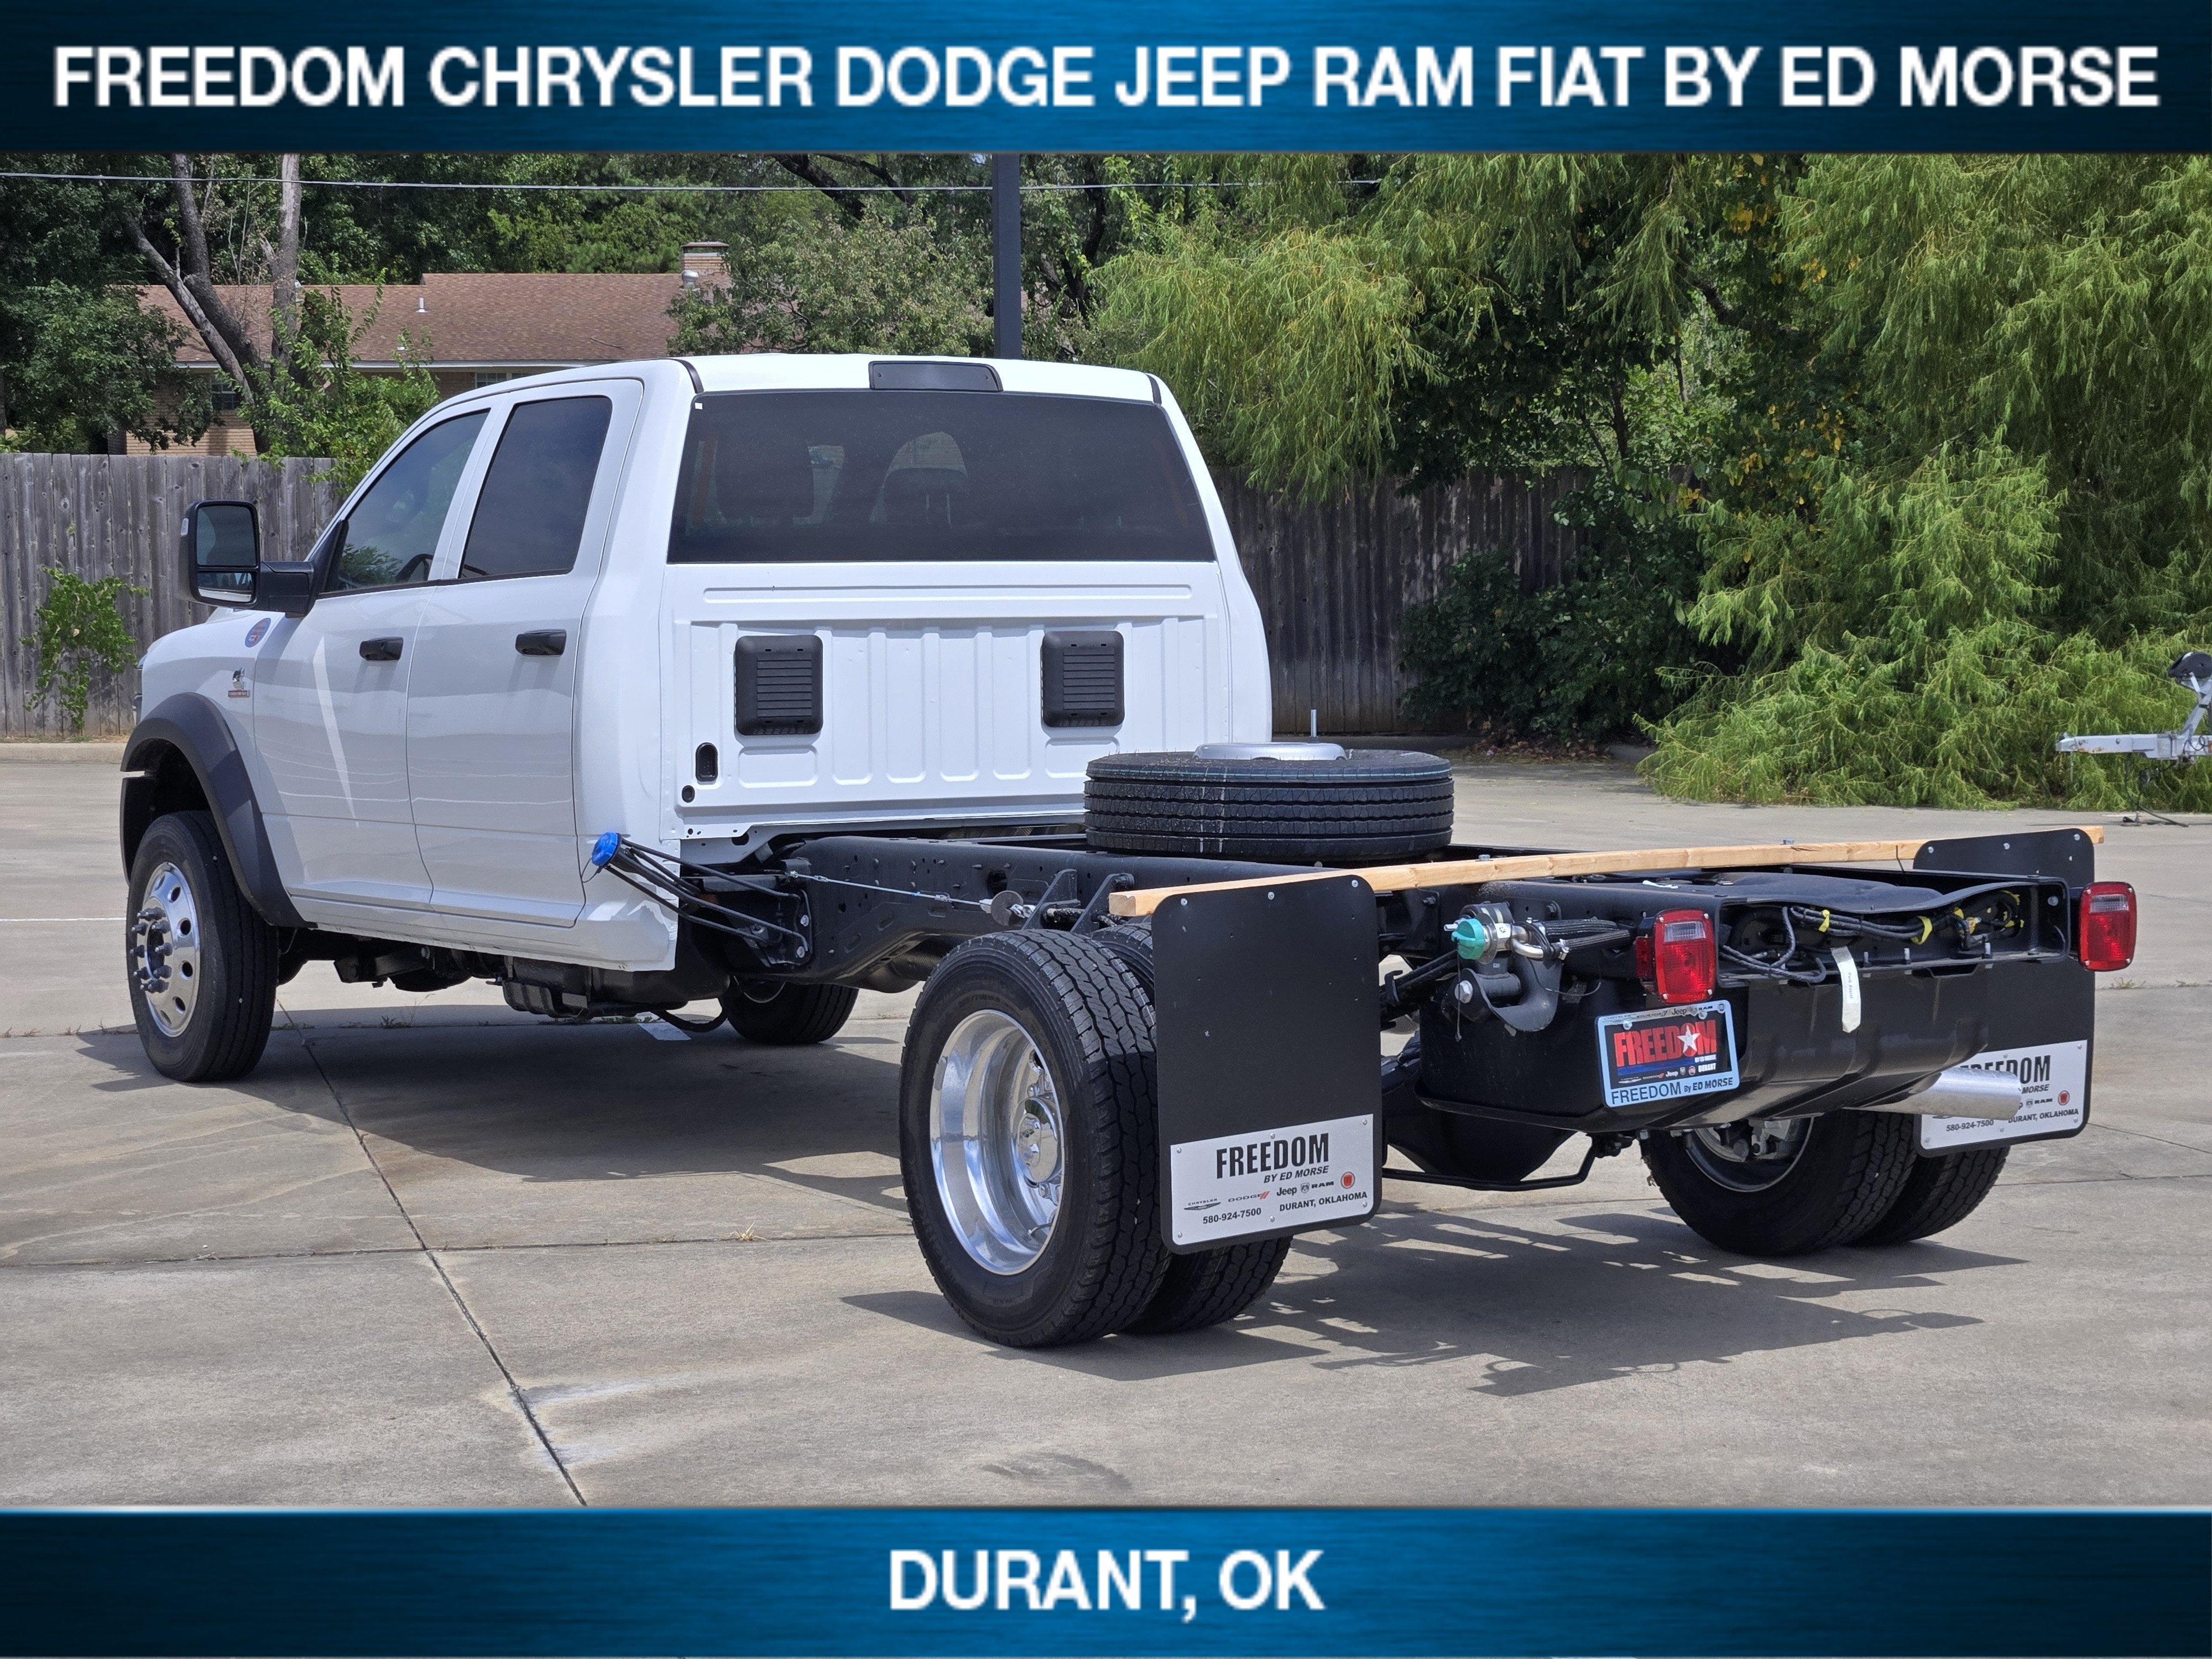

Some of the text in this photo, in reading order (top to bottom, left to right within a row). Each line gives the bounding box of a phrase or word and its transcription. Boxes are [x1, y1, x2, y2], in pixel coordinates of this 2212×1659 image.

[1614, 1019, 1717, 1067] FREEDOM
[1611, 1081, 1682, 1105] FREEDOM
[1693, 1082, 1703, 1091] ED
[1704, 1077, 1734, 1089] MORSE
[2021, 1084, 2050, 1094] MORSE
[1945, 1108, 2079, 1132] 580-924-7500 DURANT, OKLAHOMA
[1217, 1132, 1329, 1179] FREEDOM
[1264, 1165, 1330, 1183] BY ED MORSE
[1188, 1198, 1218, 1206] CHRYSLER
[1276, 1187, 1297, 1196] Jeep
[1311, 1181, 1334, 1189] RAM
[1202, 1191, 1368, 1225] 580-924-7500 DURANT, OKLAHOMA
